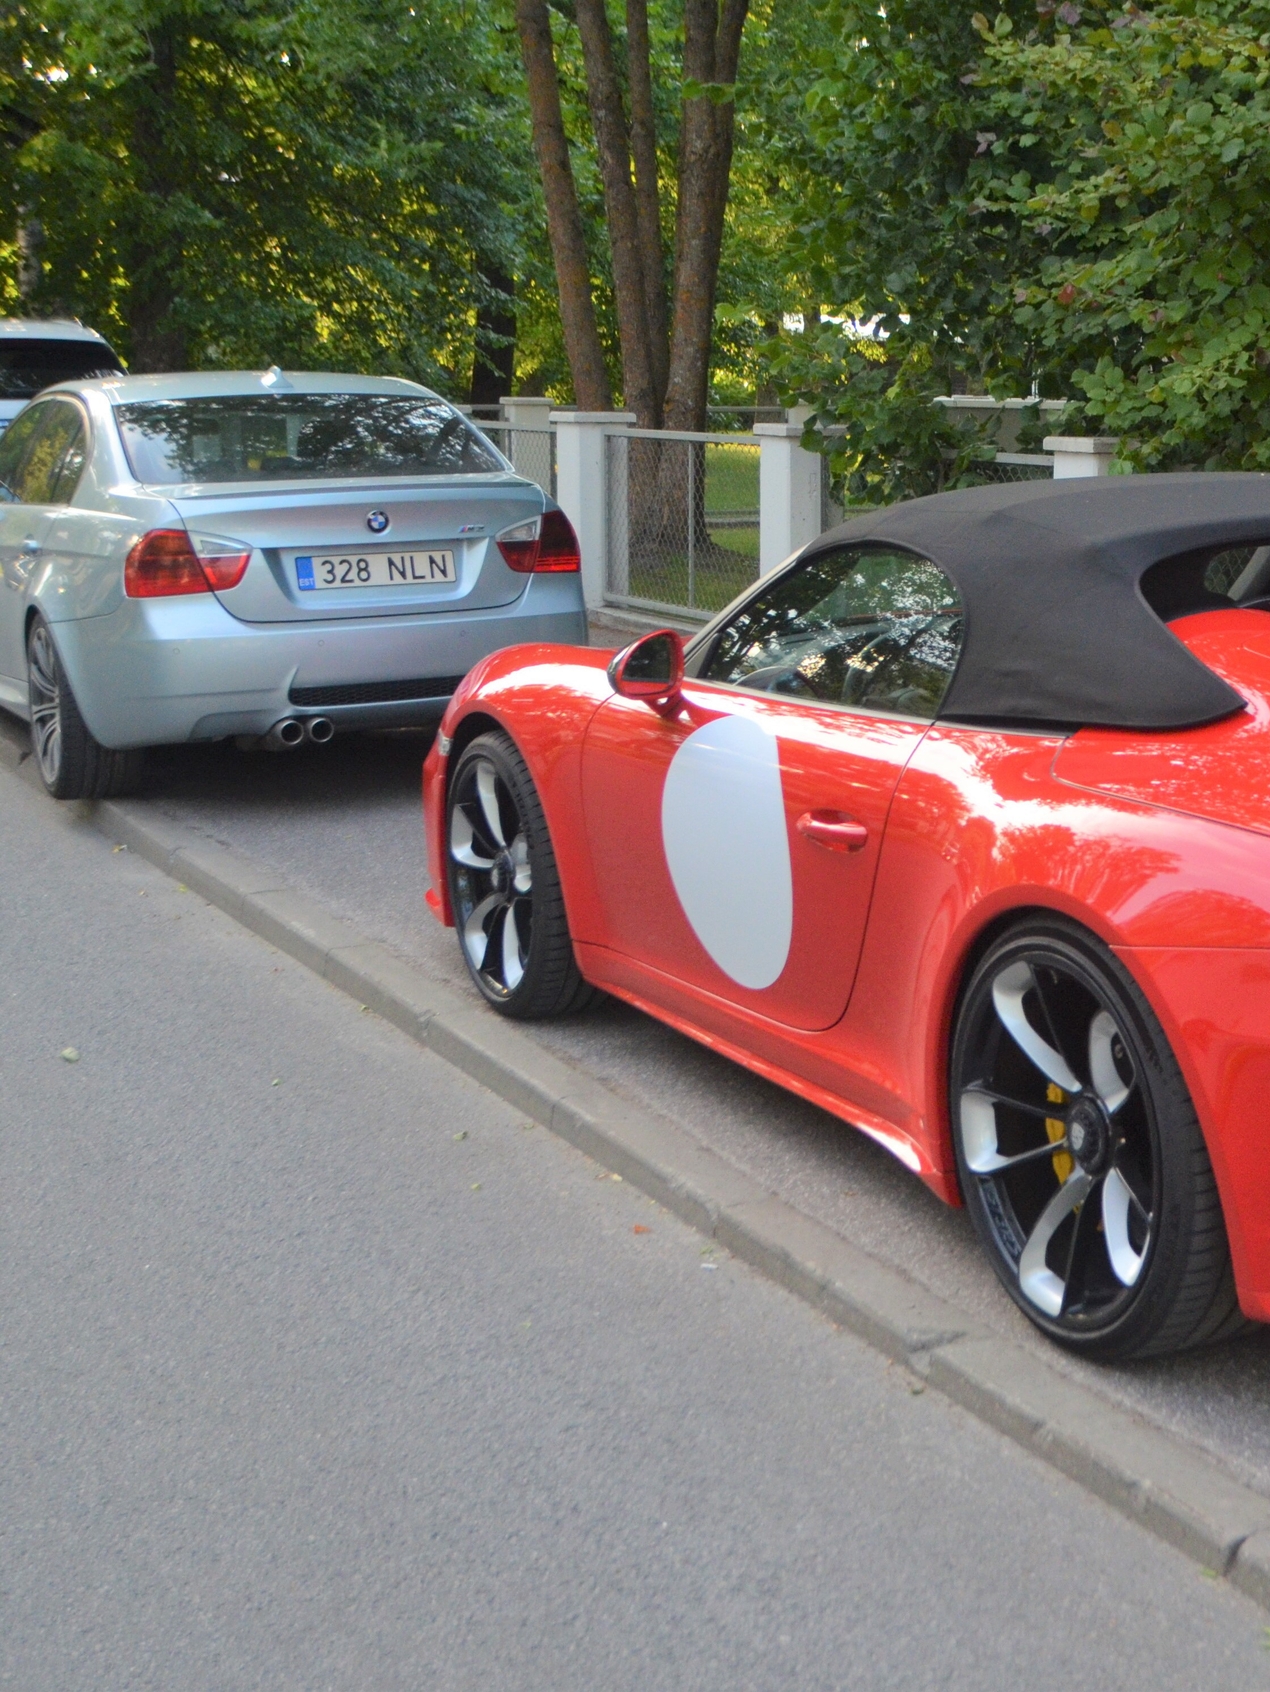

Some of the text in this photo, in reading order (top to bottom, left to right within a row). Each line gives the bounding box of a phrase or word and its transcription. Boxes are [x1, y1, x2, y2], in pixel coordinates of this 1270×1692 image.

[320, 553, 449, 585] 328 NLN
[299, 577, 315, 587] EST
